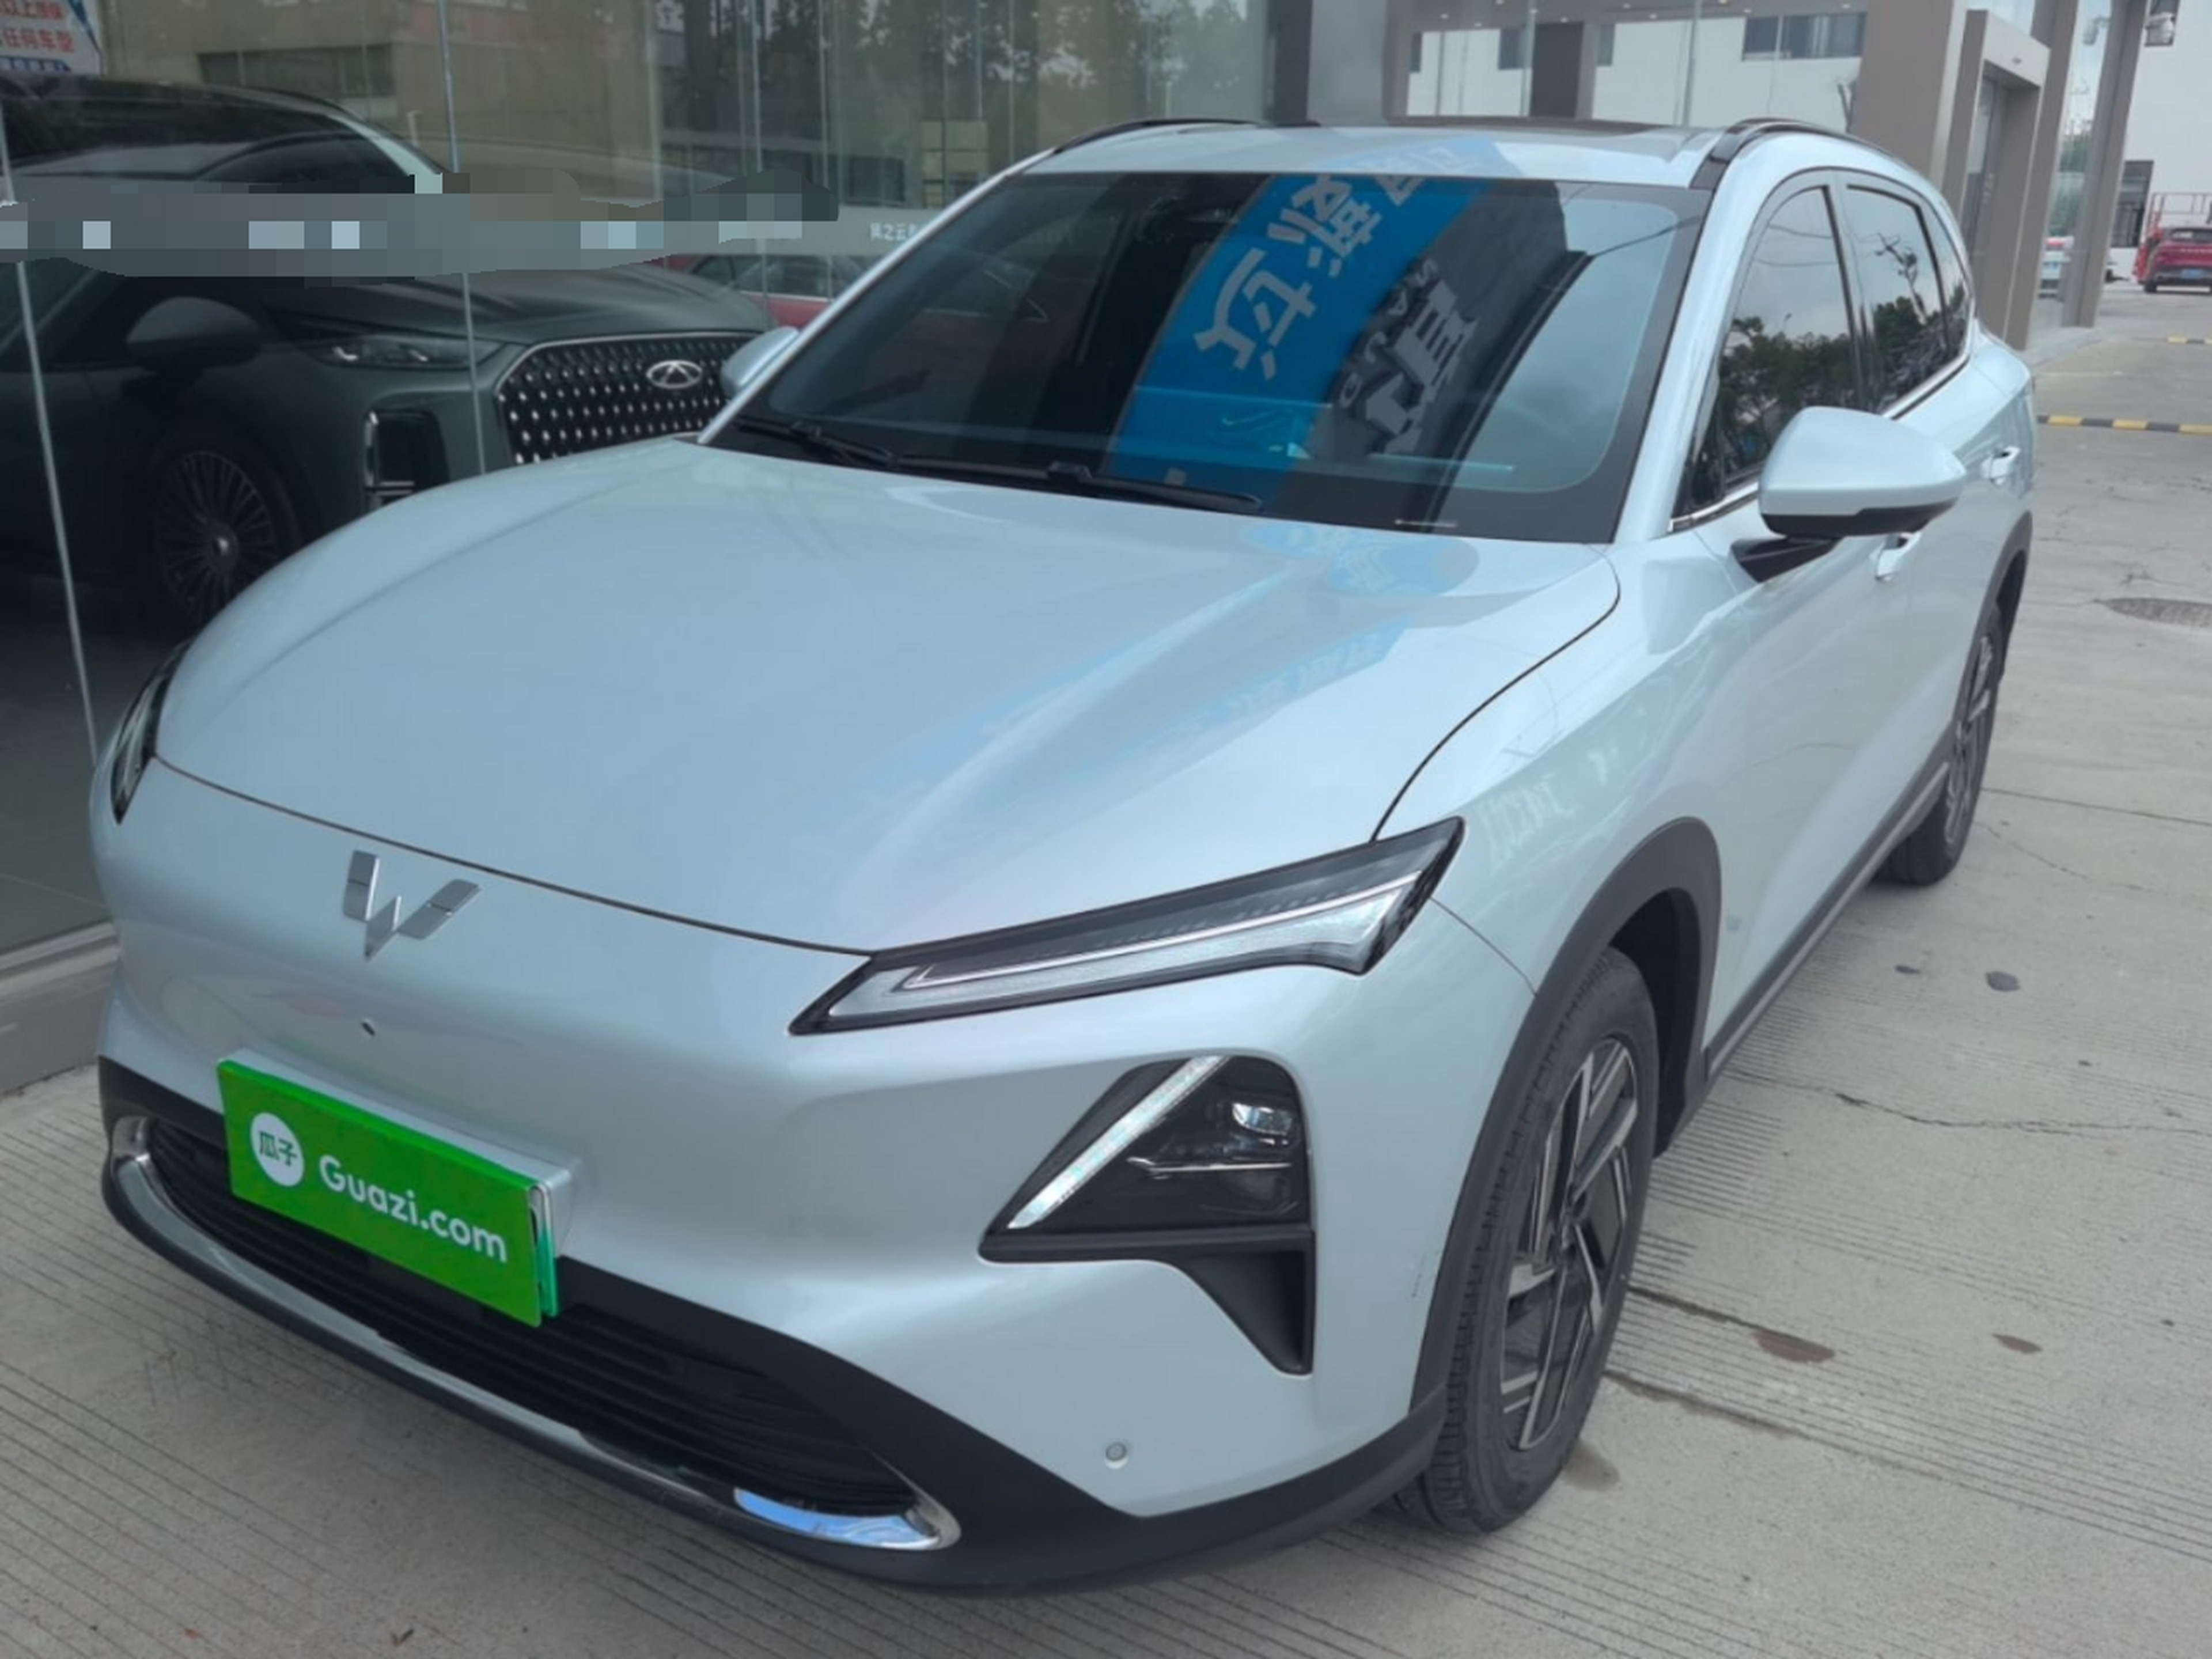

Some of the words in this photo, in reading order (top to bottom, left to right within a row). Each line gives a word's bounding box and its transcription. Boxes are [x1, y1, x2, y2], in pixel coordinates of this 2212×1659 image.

[0, 27, 75, 53] 任何车型
[259, 1131, 298, 1167] 瓜子
[319, 1154, 507, 1263] Guazi.com
